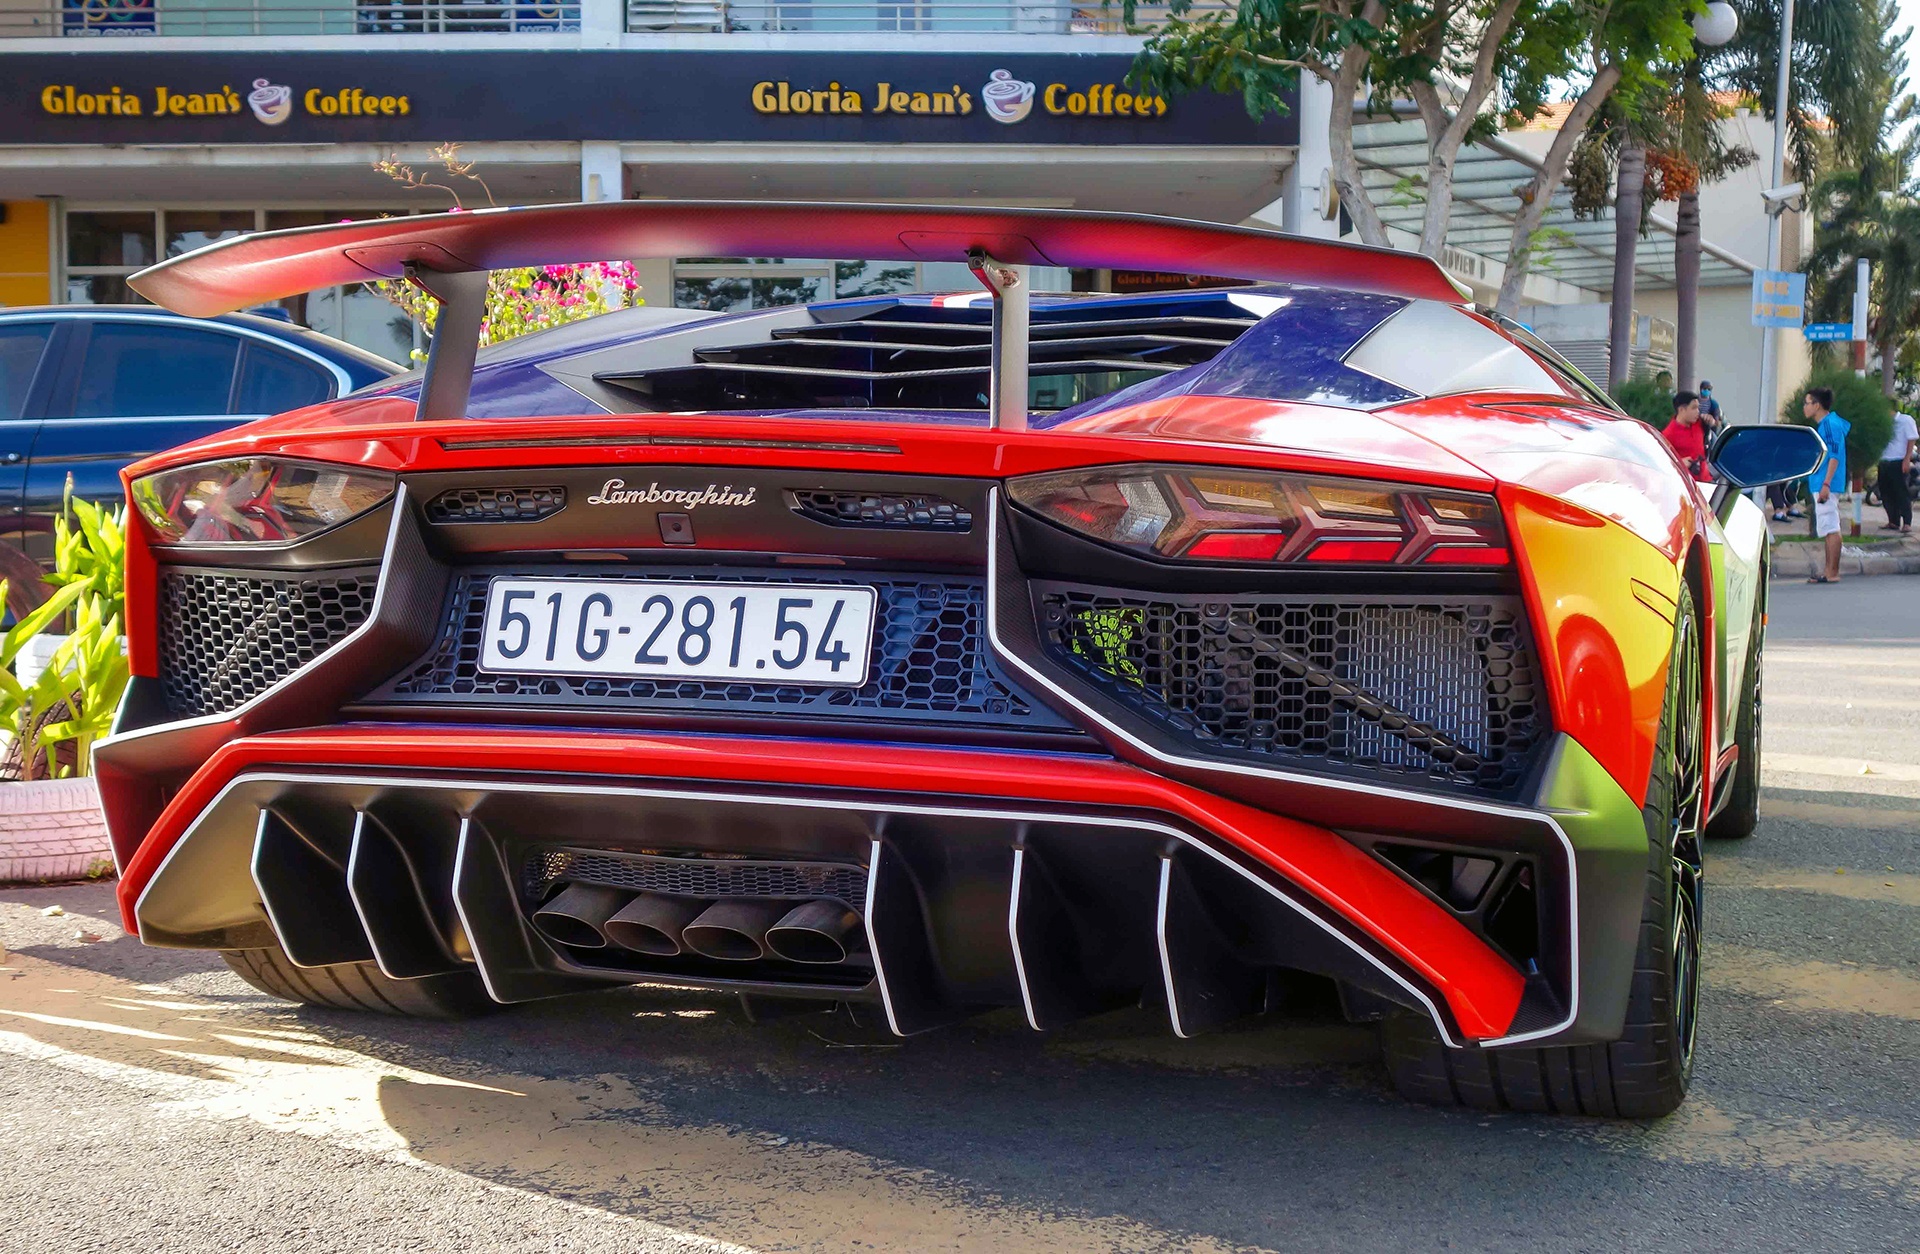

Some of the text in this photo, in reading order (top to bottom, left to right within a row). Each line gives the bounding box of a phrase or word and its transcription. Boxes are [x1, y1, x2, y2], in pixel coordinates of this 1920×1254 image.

[41, 85, 410, 115] Gloria Jean's Coffees
[752, 81, 1168, 116] Gloria Jean's Coffees
[1117, 273, 1151, 285] Gloria
[587, 478, 756, 510] Lamborghini
[496, 590, 851, 673] 51G-281.54
